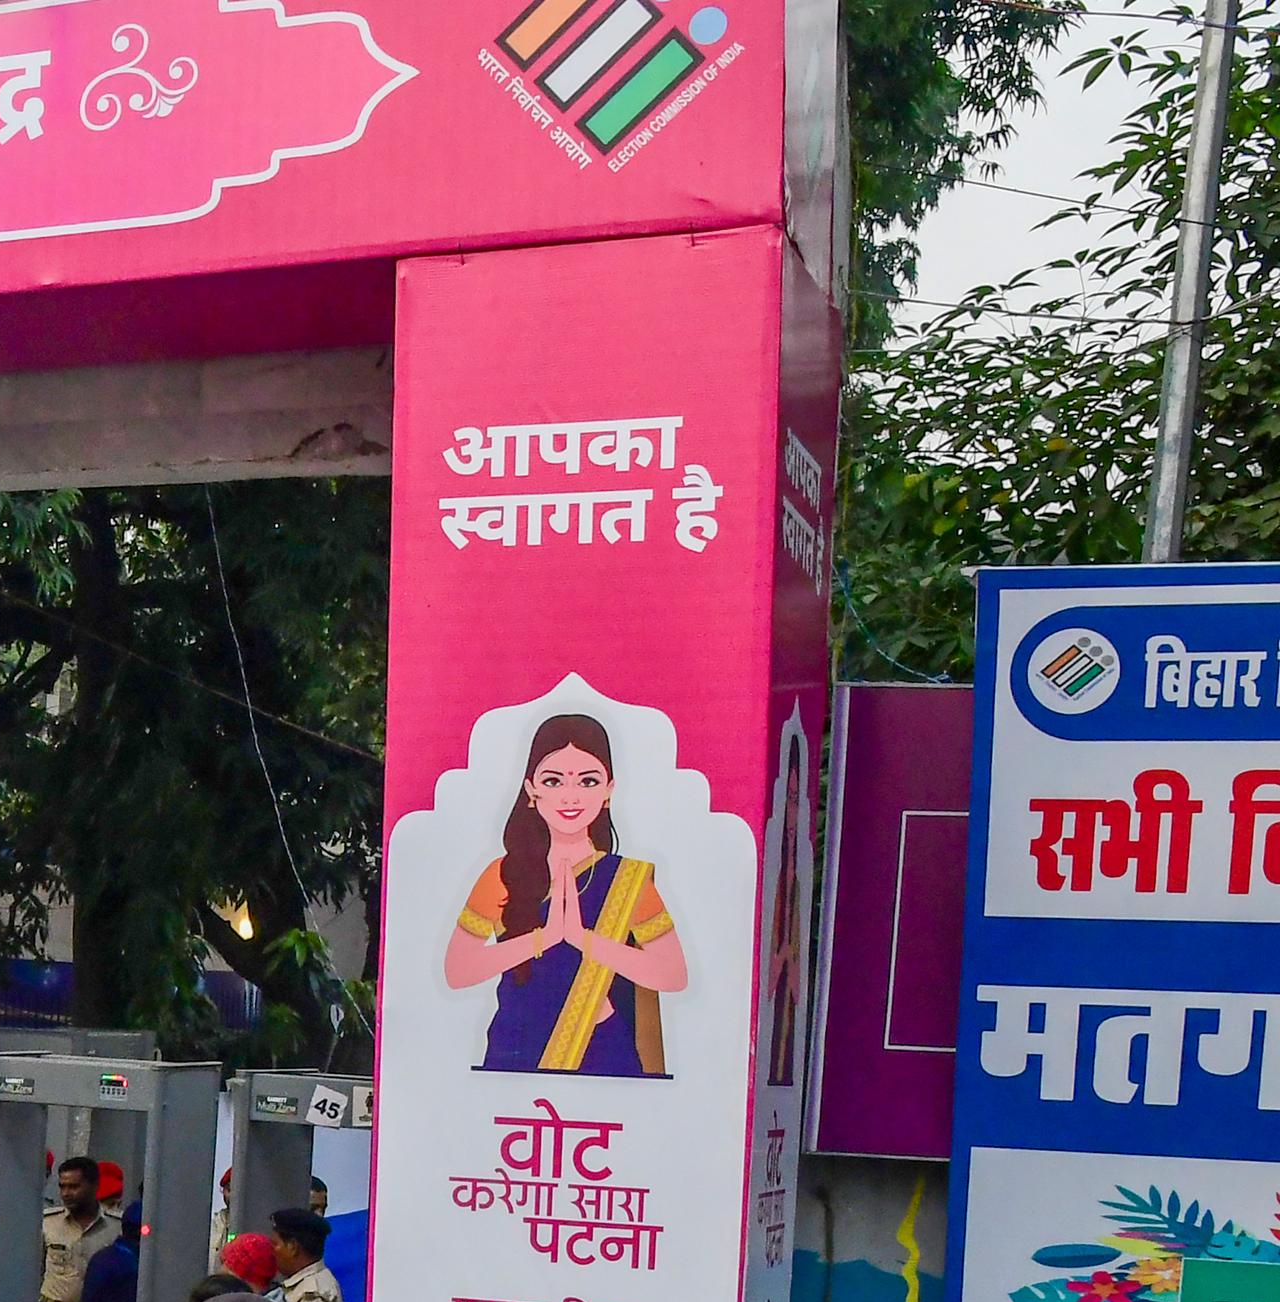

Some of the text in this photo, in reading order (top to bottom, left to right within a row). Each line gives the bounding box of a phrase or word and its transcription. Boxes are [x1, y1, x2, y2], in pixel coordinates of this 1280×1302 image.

[476, 47, 593, 170] भारत निर्वाचन आयोग
[607, 41, 746, 174] ELECTION COMMISSION OF INDIA
[442, 416, 684, 478] आपका
[438, 464, 725, 553] स्वागत है
[1143, 634, 1267, 709] बिहार
[1029, 769, 1203, 895] सभी
[976, 984, 1280, 1111] मतग
[314, 1098, 341, 1120] 45
[494, 1097, 623, 1181] वोट
[449, 1167, 650, 1223] करेगा सारा
[523, 1217, 664, 1271] पटना
